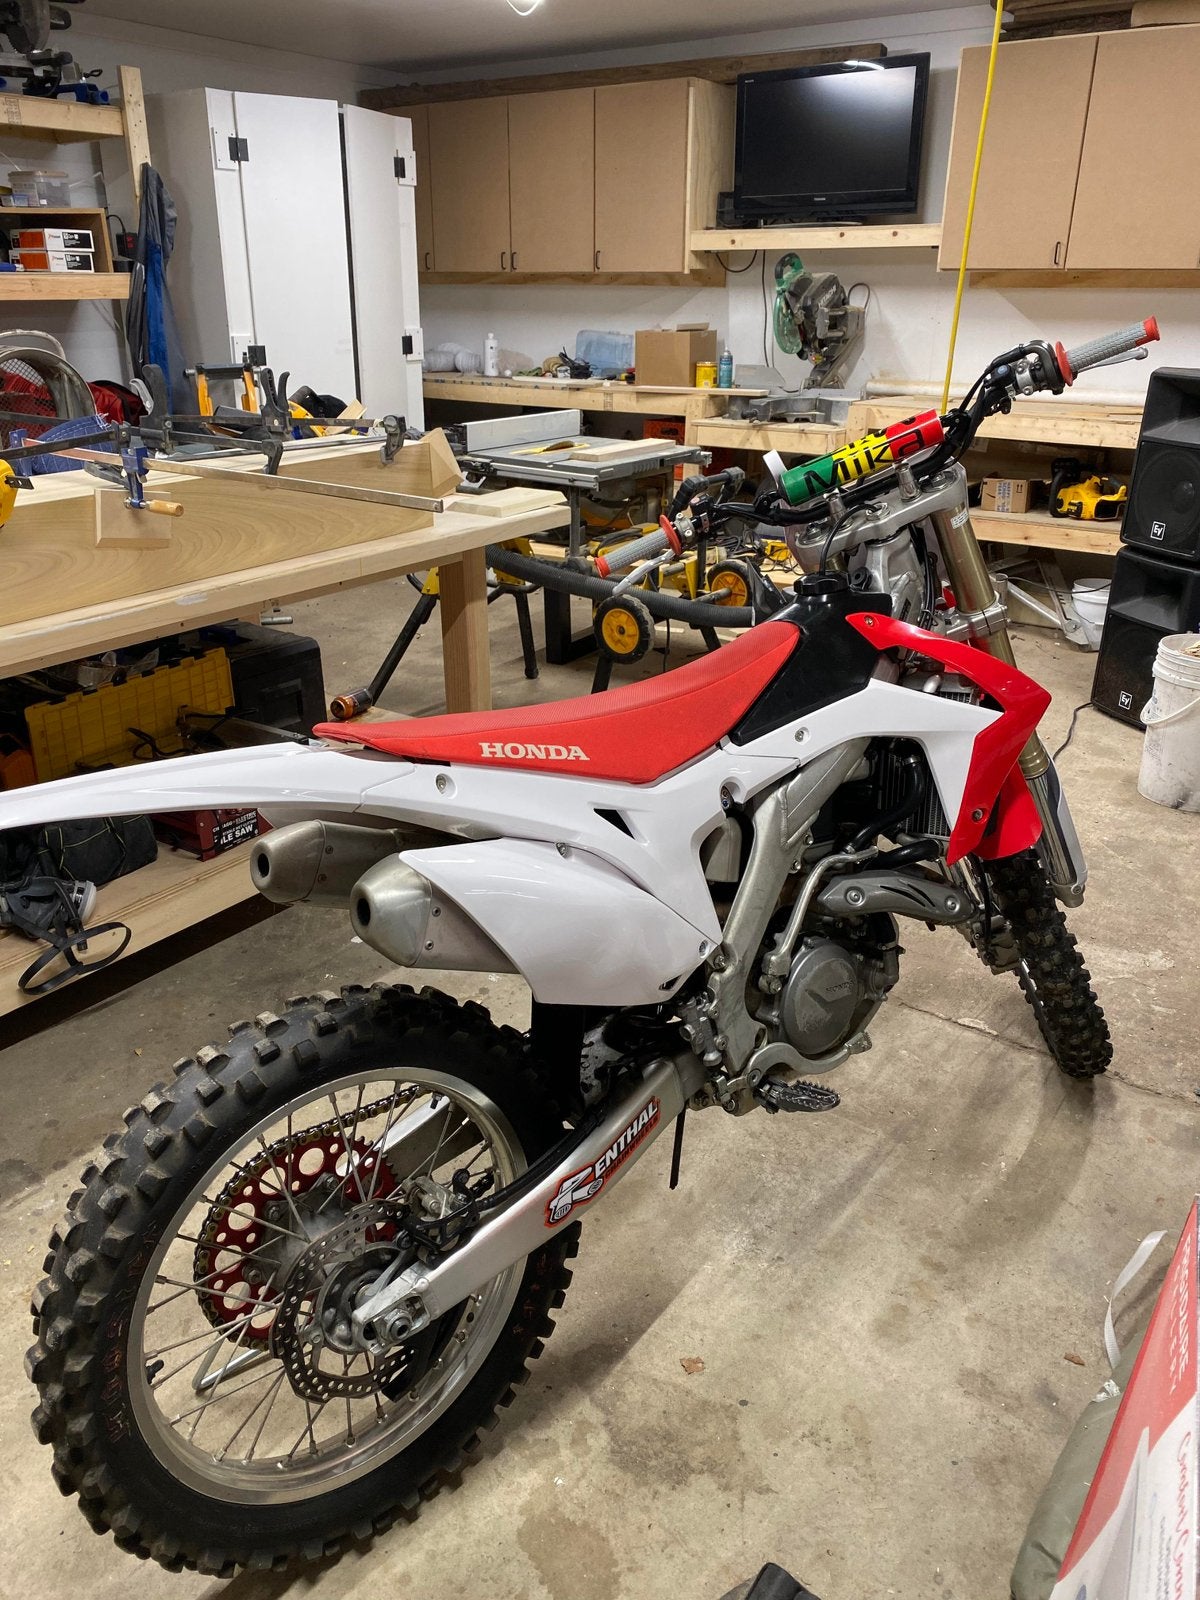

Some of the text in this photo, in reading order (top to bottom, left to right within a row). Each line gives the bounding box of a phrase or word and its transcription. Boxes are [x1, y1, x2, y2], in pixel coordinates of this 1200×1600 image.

[479, 742, 590, 761] HONDA
[235, 824, 253, 838] SAW
[549, 1101, 658, 1223] RENTHAL
[1178, 1232, 1192, 1382] FRIGIDAIRE
